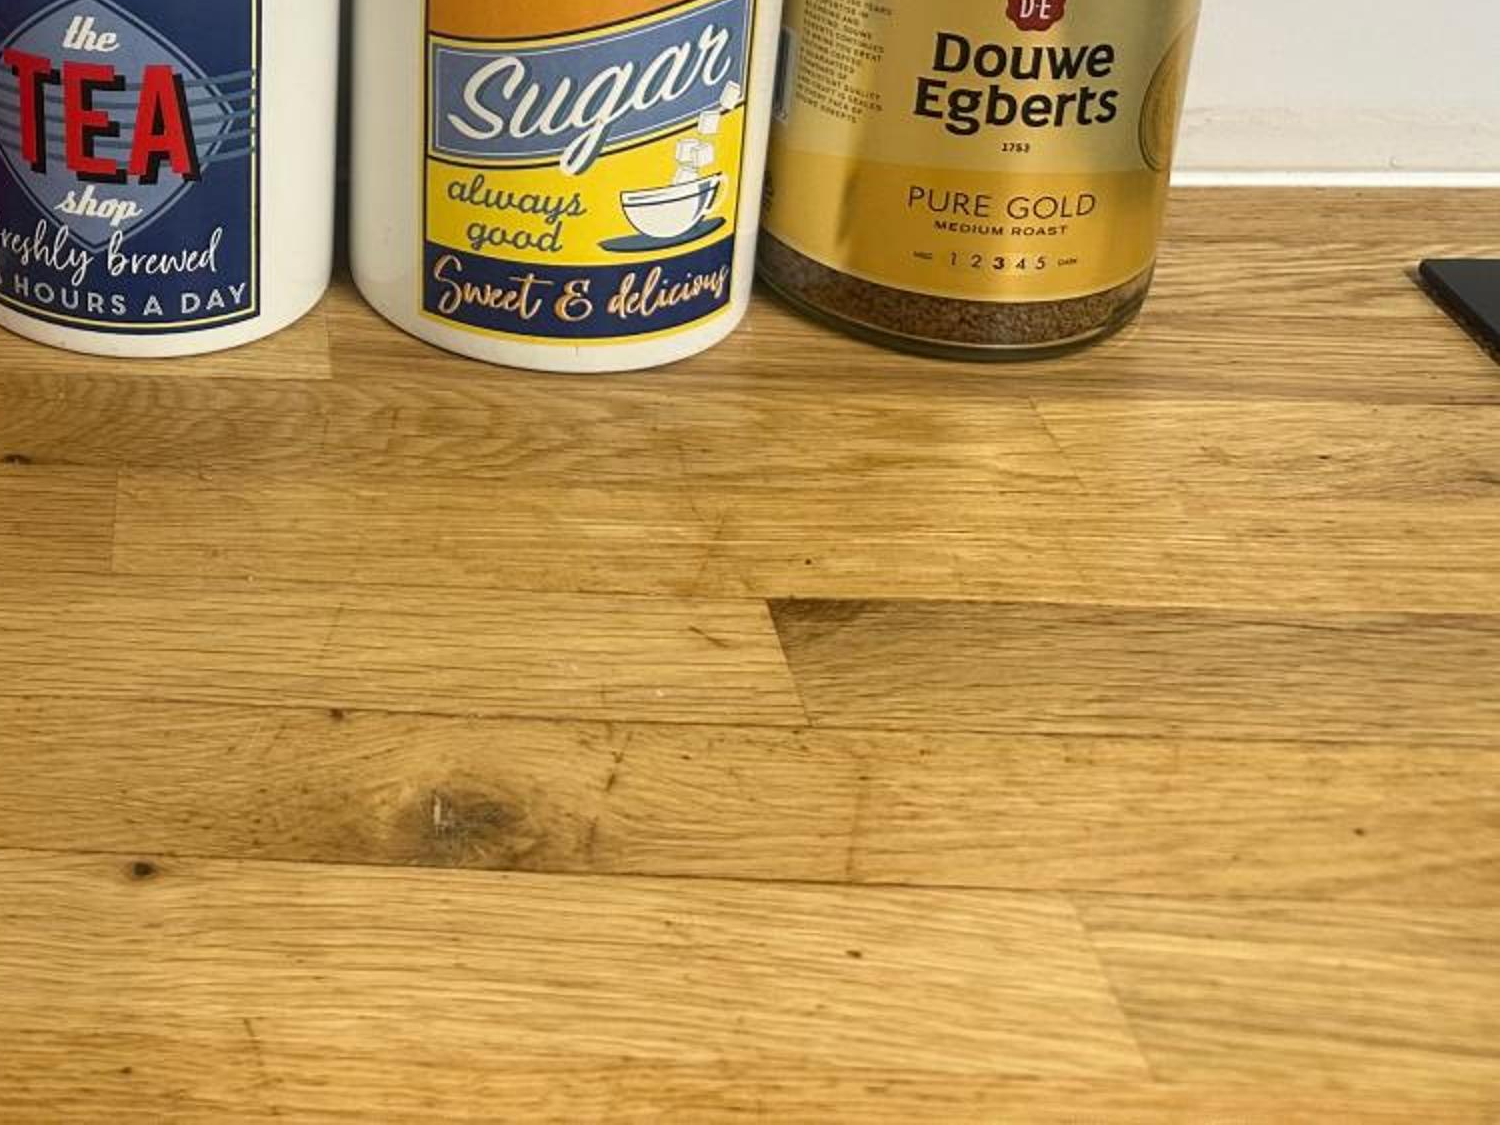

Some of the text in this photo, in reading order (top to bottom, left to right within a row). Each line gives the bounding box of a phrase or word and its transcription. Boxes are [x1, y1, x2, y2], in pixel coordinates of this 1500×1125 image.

[62, 15, 120, 52] the
[932, 32, 1115, 80] Douwe
[3, 49, 202, 184] TEA
[447, 23, 731, 176] Sugar
[913, 77, 1119, 136] Egberts
[1001, 142, 1030, 153] 1753
[54, 185, 143, 226] shop
[447, 174, 587, 224] always
[908, 185, 1097, 219] PURE GOLD
[466, 221, 564, 253] good
[934, 221, 1069, 236] MEDIUM ROAST
[107, 226, 223, 276] brewed
[950, 252, 958, 266] 1
[971, 255, 982, 268] 2
[993, 256, 1005, 270] 3
[1016, 257, 1026, 270] 4
[1035, 256, 1046, 270] 5
[13, 275, 128, 315] HOURS
[142, 298, 164, 316] A
[181, 282, 247, 314] DAY
[433, 254, 731, 322] Sweet & delicious
